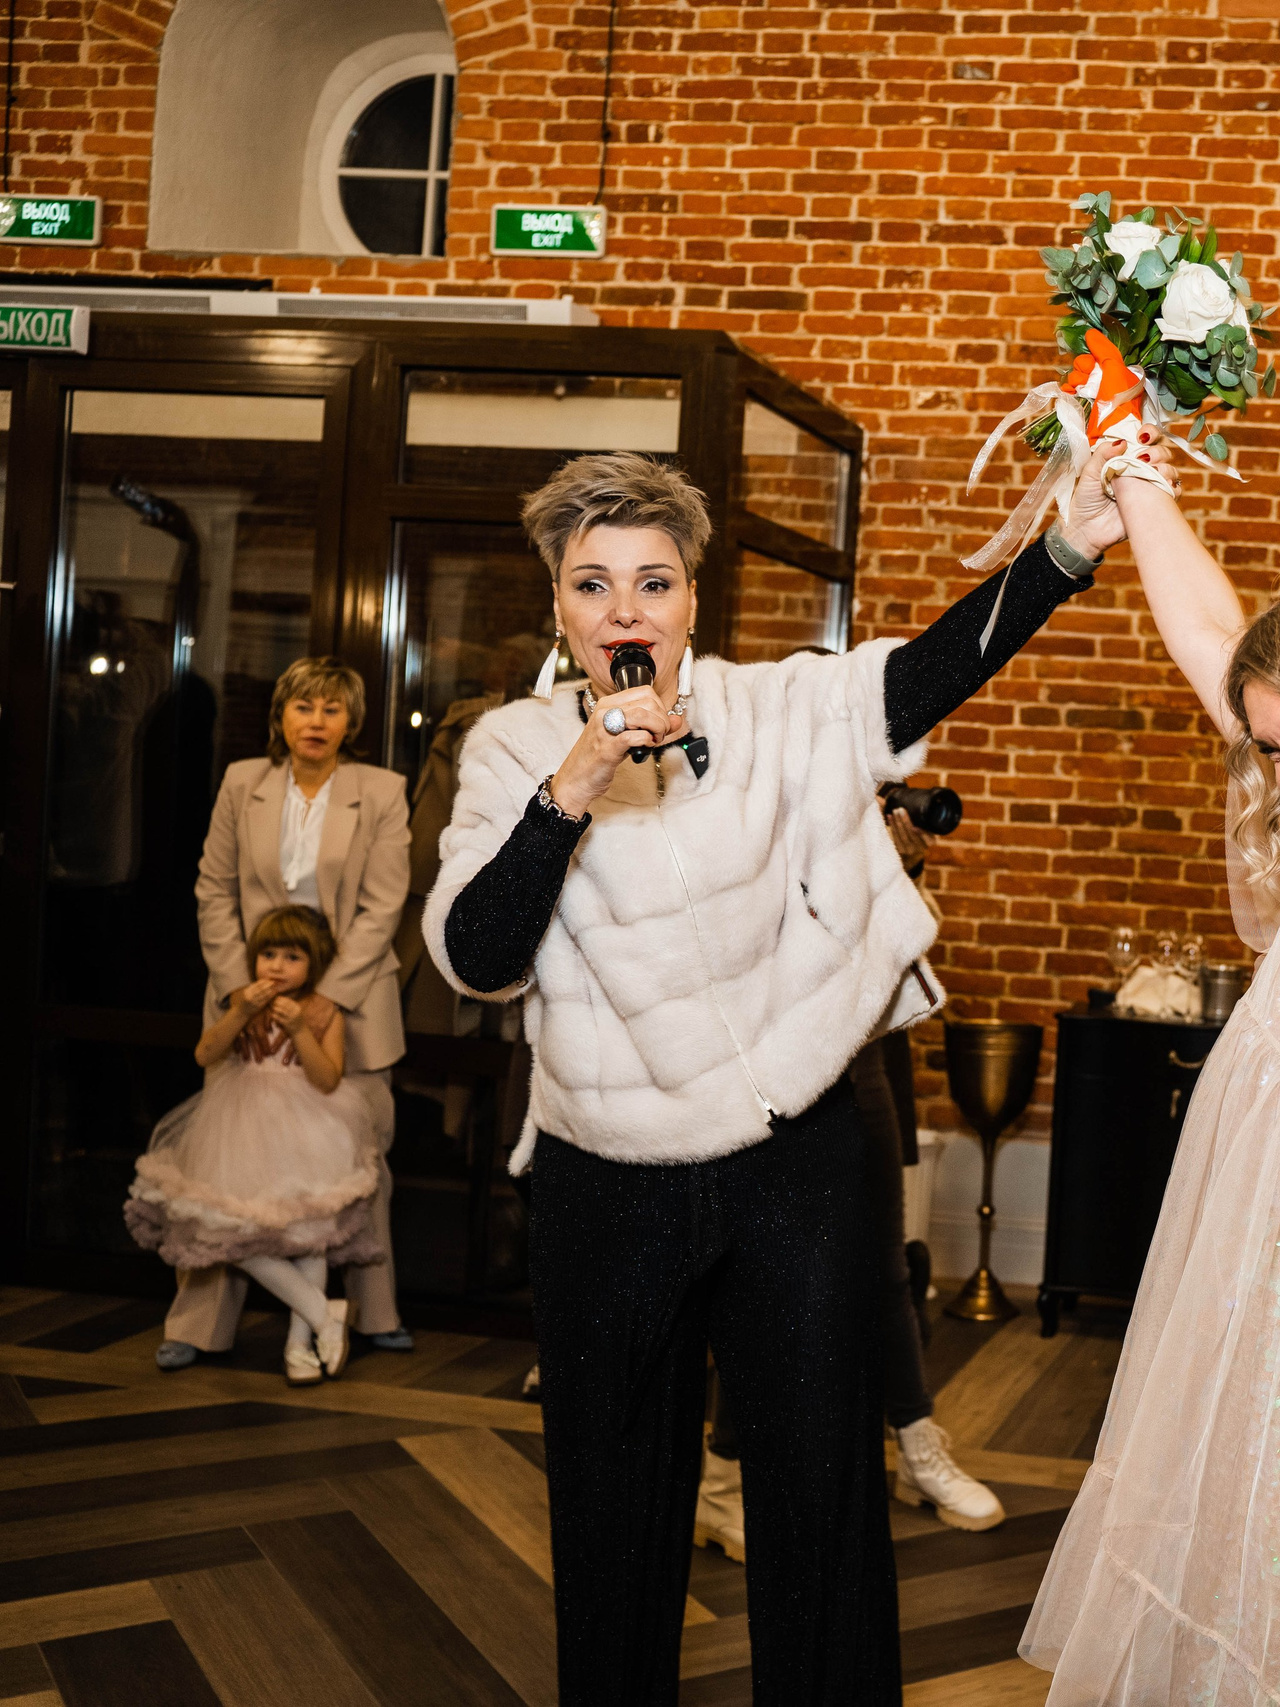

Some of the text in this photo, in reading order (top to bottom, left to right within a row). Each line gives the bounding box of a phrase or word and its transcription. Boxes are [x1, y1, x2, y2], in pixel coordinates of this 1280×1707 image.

[22, 202, 70, 223] ВЫХОД
[31, 221, 60, 235] EXIT
[521, 213, 573, 235] ВЫХОД
[531, 233, 564, 247] EXIT
[0, 310, 66, 345] ЫХОД
